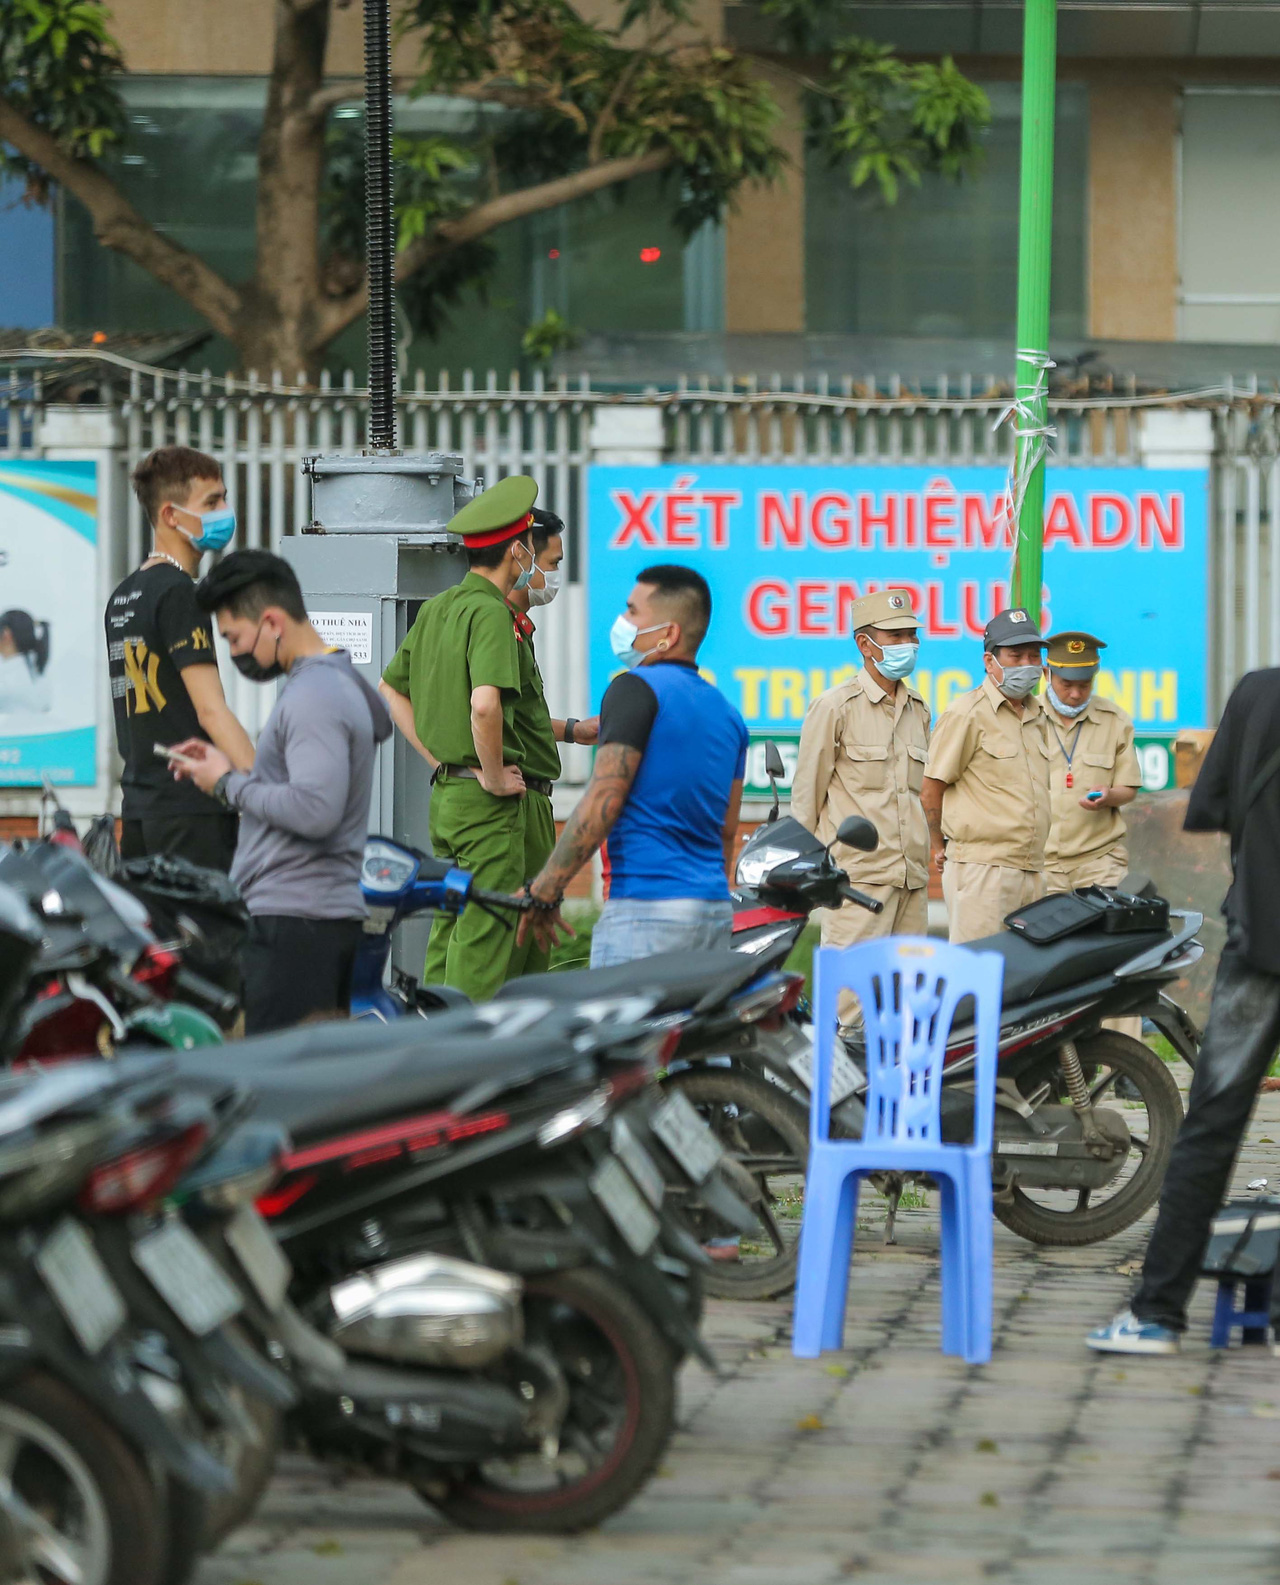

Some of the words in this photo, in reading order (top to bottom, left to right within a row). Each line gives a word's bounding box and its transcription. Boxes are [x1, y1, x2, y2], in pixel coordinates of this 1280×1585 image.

[612, 476, 740, 548] XÉT
[760, 478, 1014, 565] NGHIỆM
[1042, 494, 1184, 549] ADN
[747, 580, 1050, 639] GENLU
